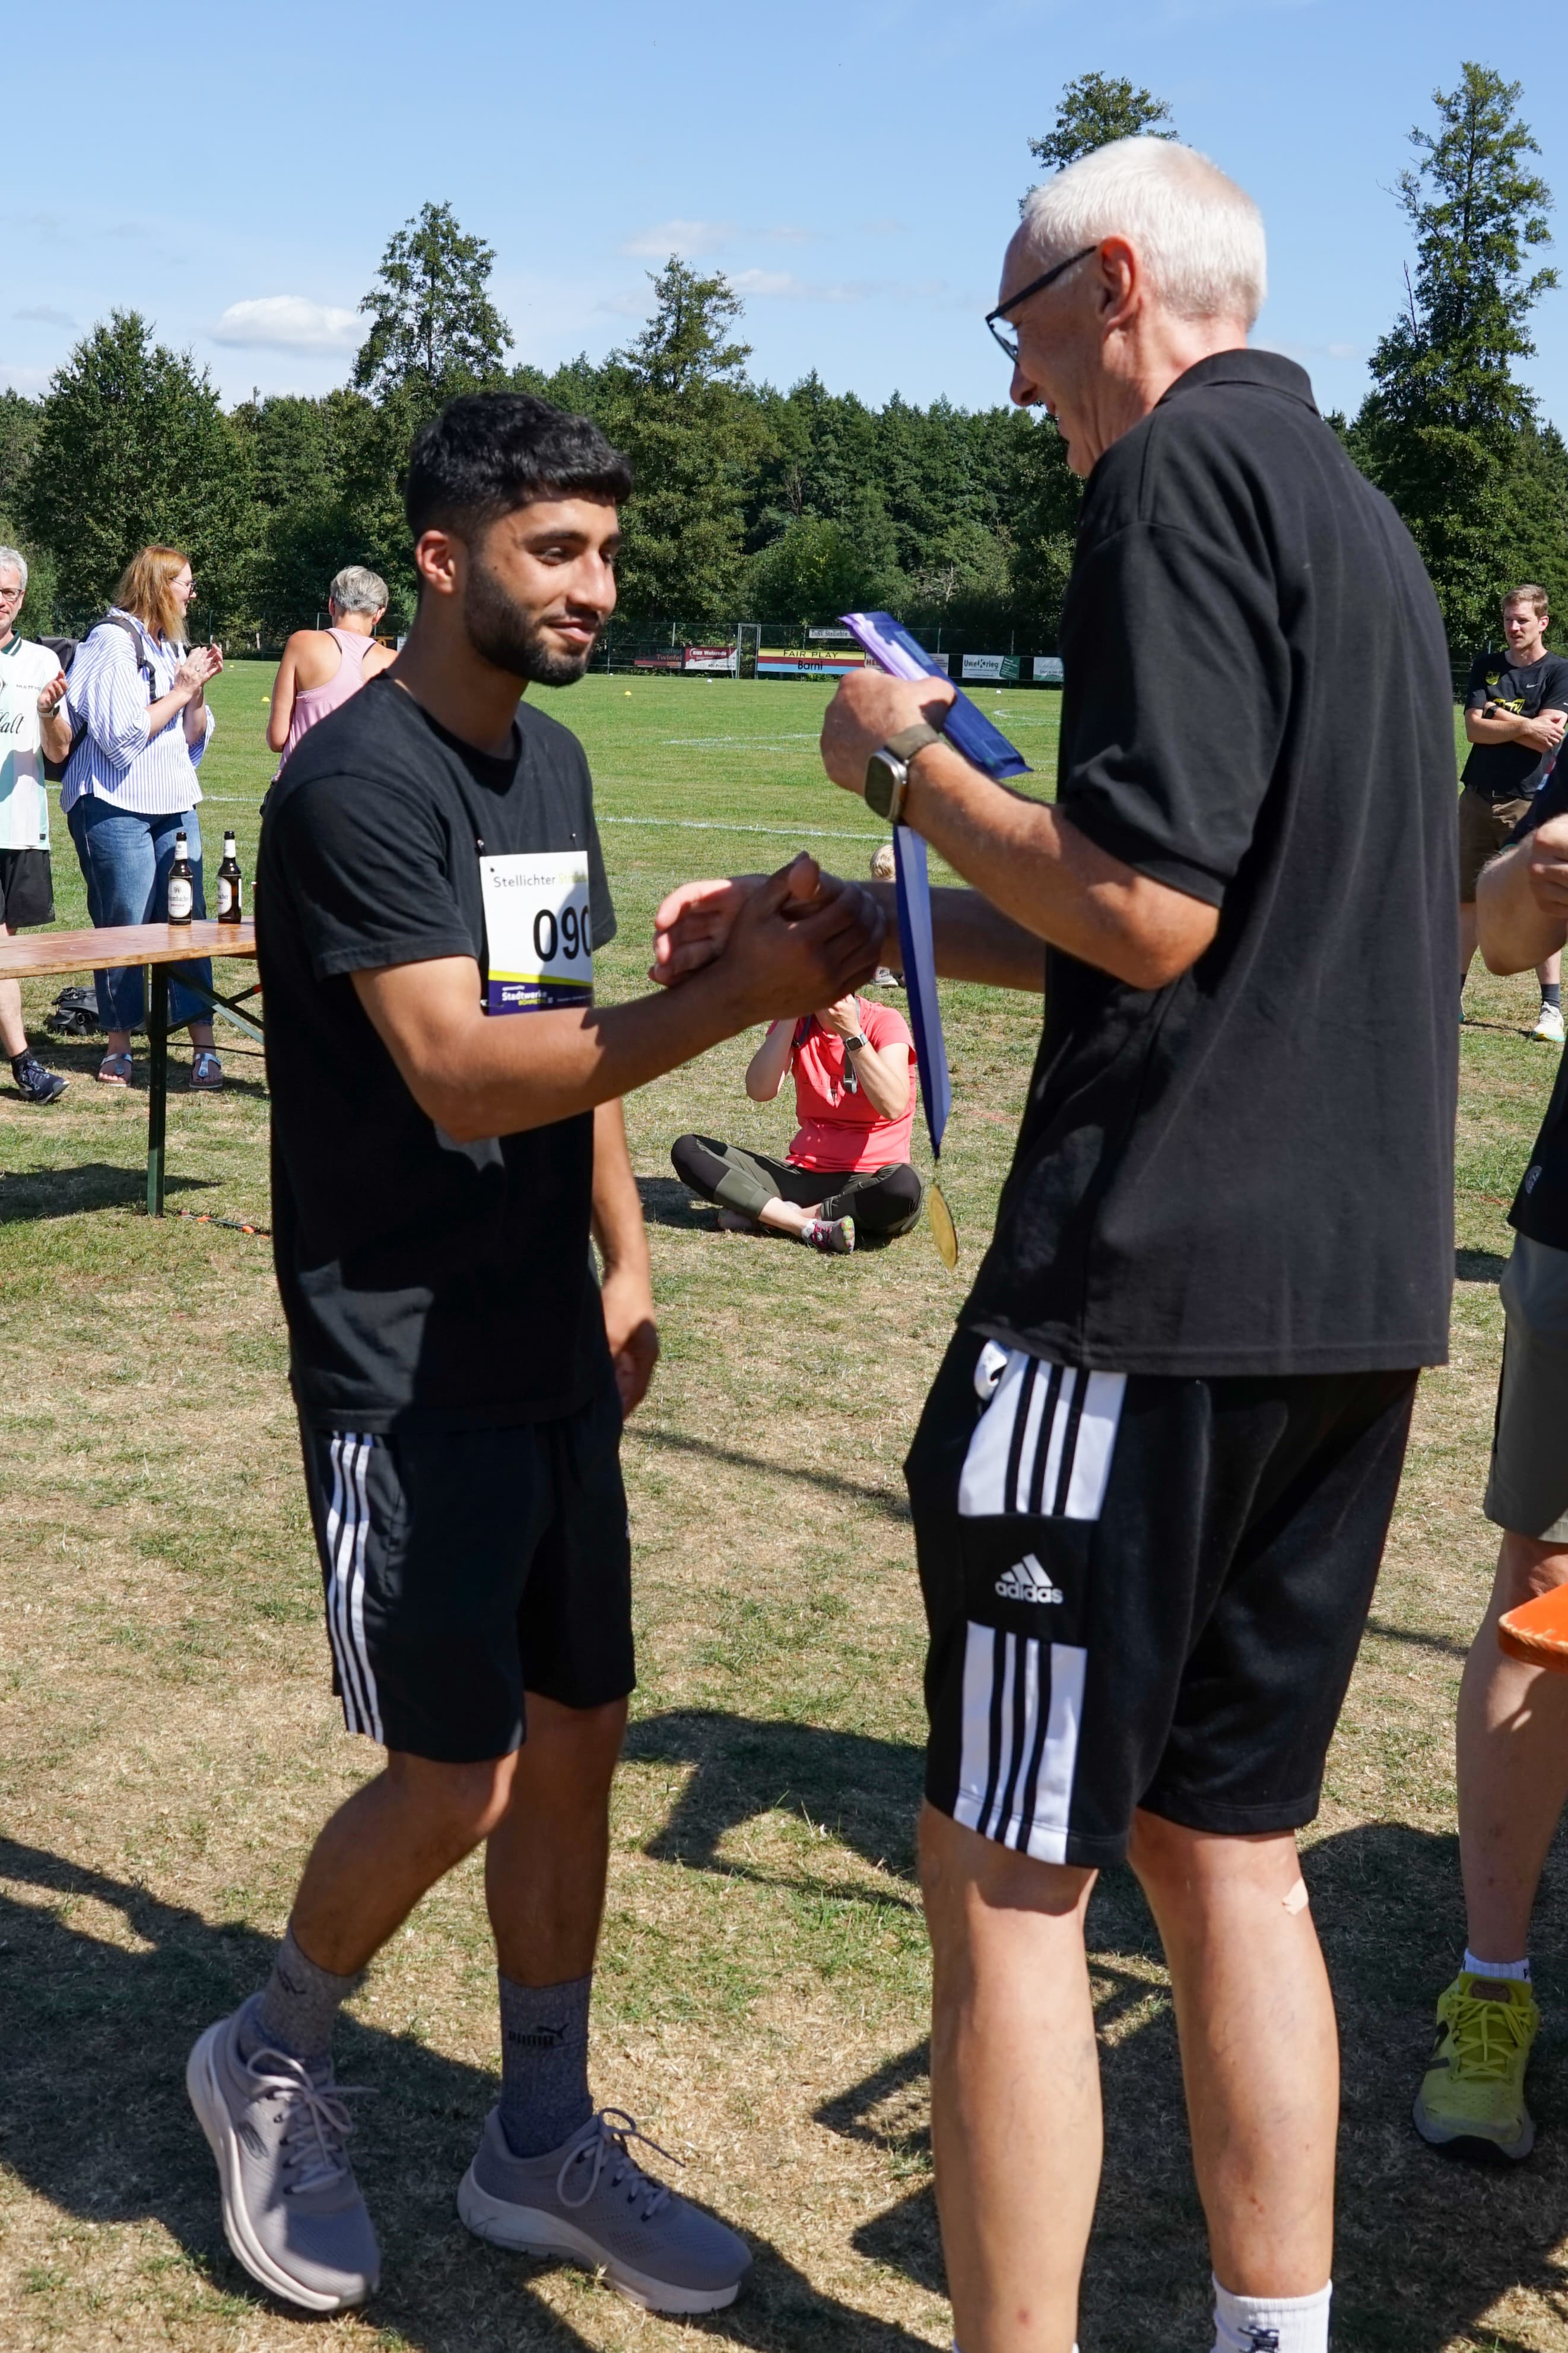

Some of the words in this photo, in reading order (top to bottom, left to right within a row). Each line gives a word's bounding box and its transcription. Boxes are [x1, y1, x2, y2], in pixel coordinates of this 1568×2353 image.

[783, 649, 806, 658] FAIR
[798, 660, 823, 671] Barni
[964, 659, 978, 668] Uwe
[493, 874, 556, 889] Stellichter
[994, 1580, 1064, 1604] adidas
[509, 2030, 554, 2048] PUMA
